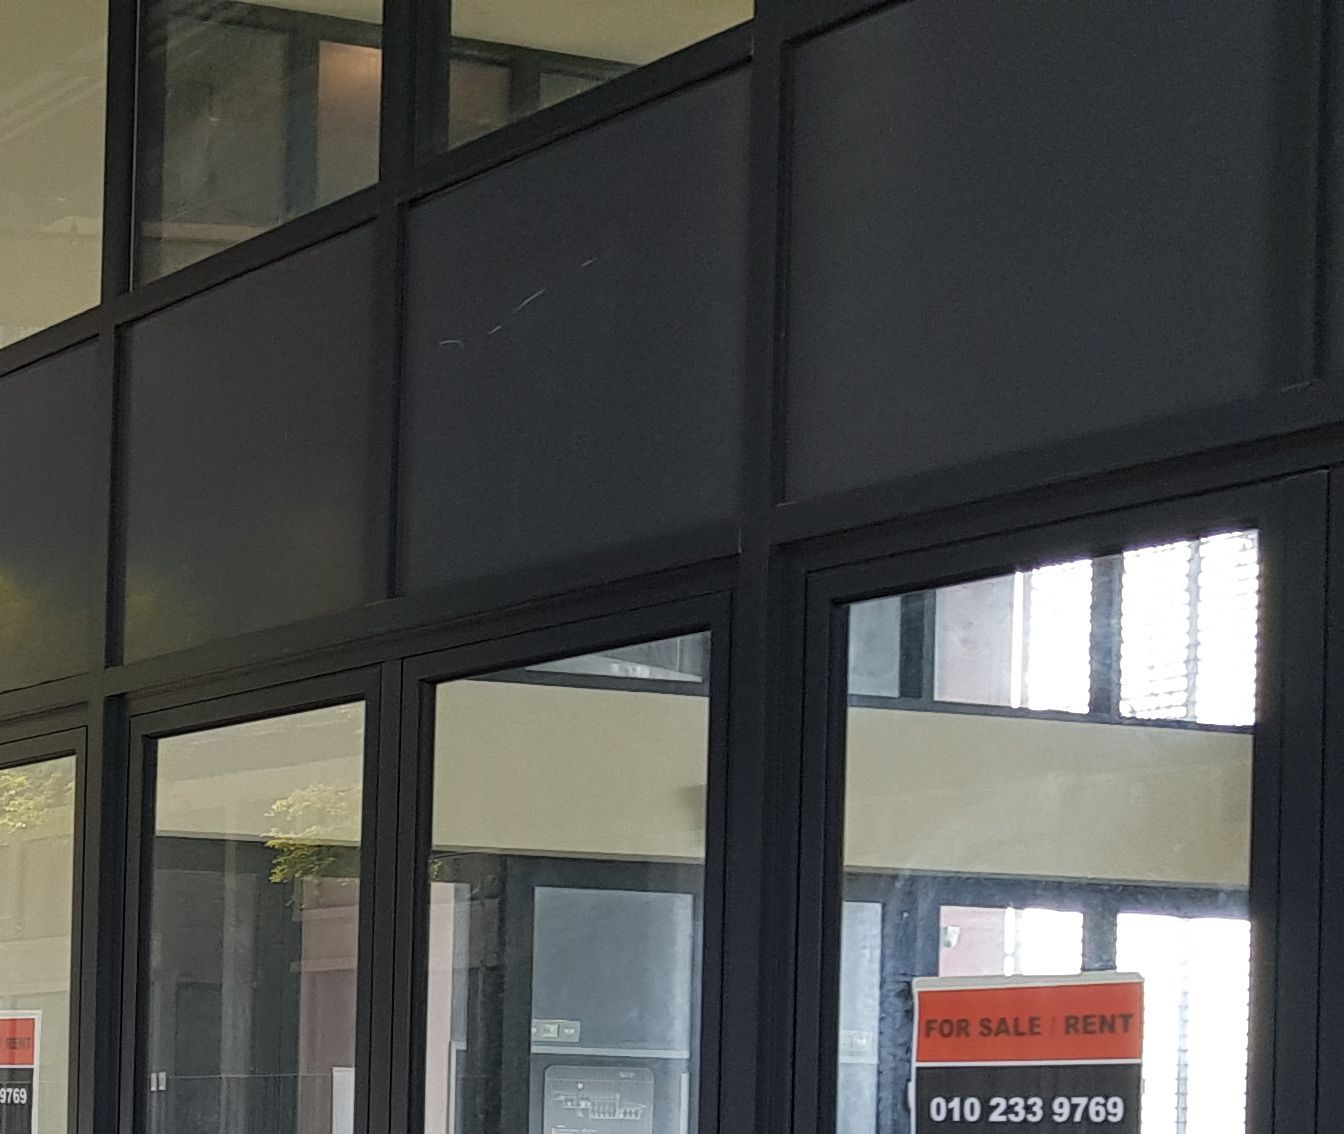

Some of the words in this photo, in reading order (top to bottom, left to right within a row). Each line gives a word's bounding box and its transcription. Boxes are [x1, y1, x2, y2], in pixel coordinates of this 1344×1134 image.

[924, 1018, 971, 1040] FOR
[978, 1015, 1043, 1038] SALE
[1064, 1012, 1135, 1036] RENT
[4, 1037, 32, 1049] RENT
[0, 1088, 27, 1104] 9769
[929, 1096, 981, 1123] 010
[989, 1096, 1044, 1123] 233
[1052, 1096, 1125, 1124] 9769
